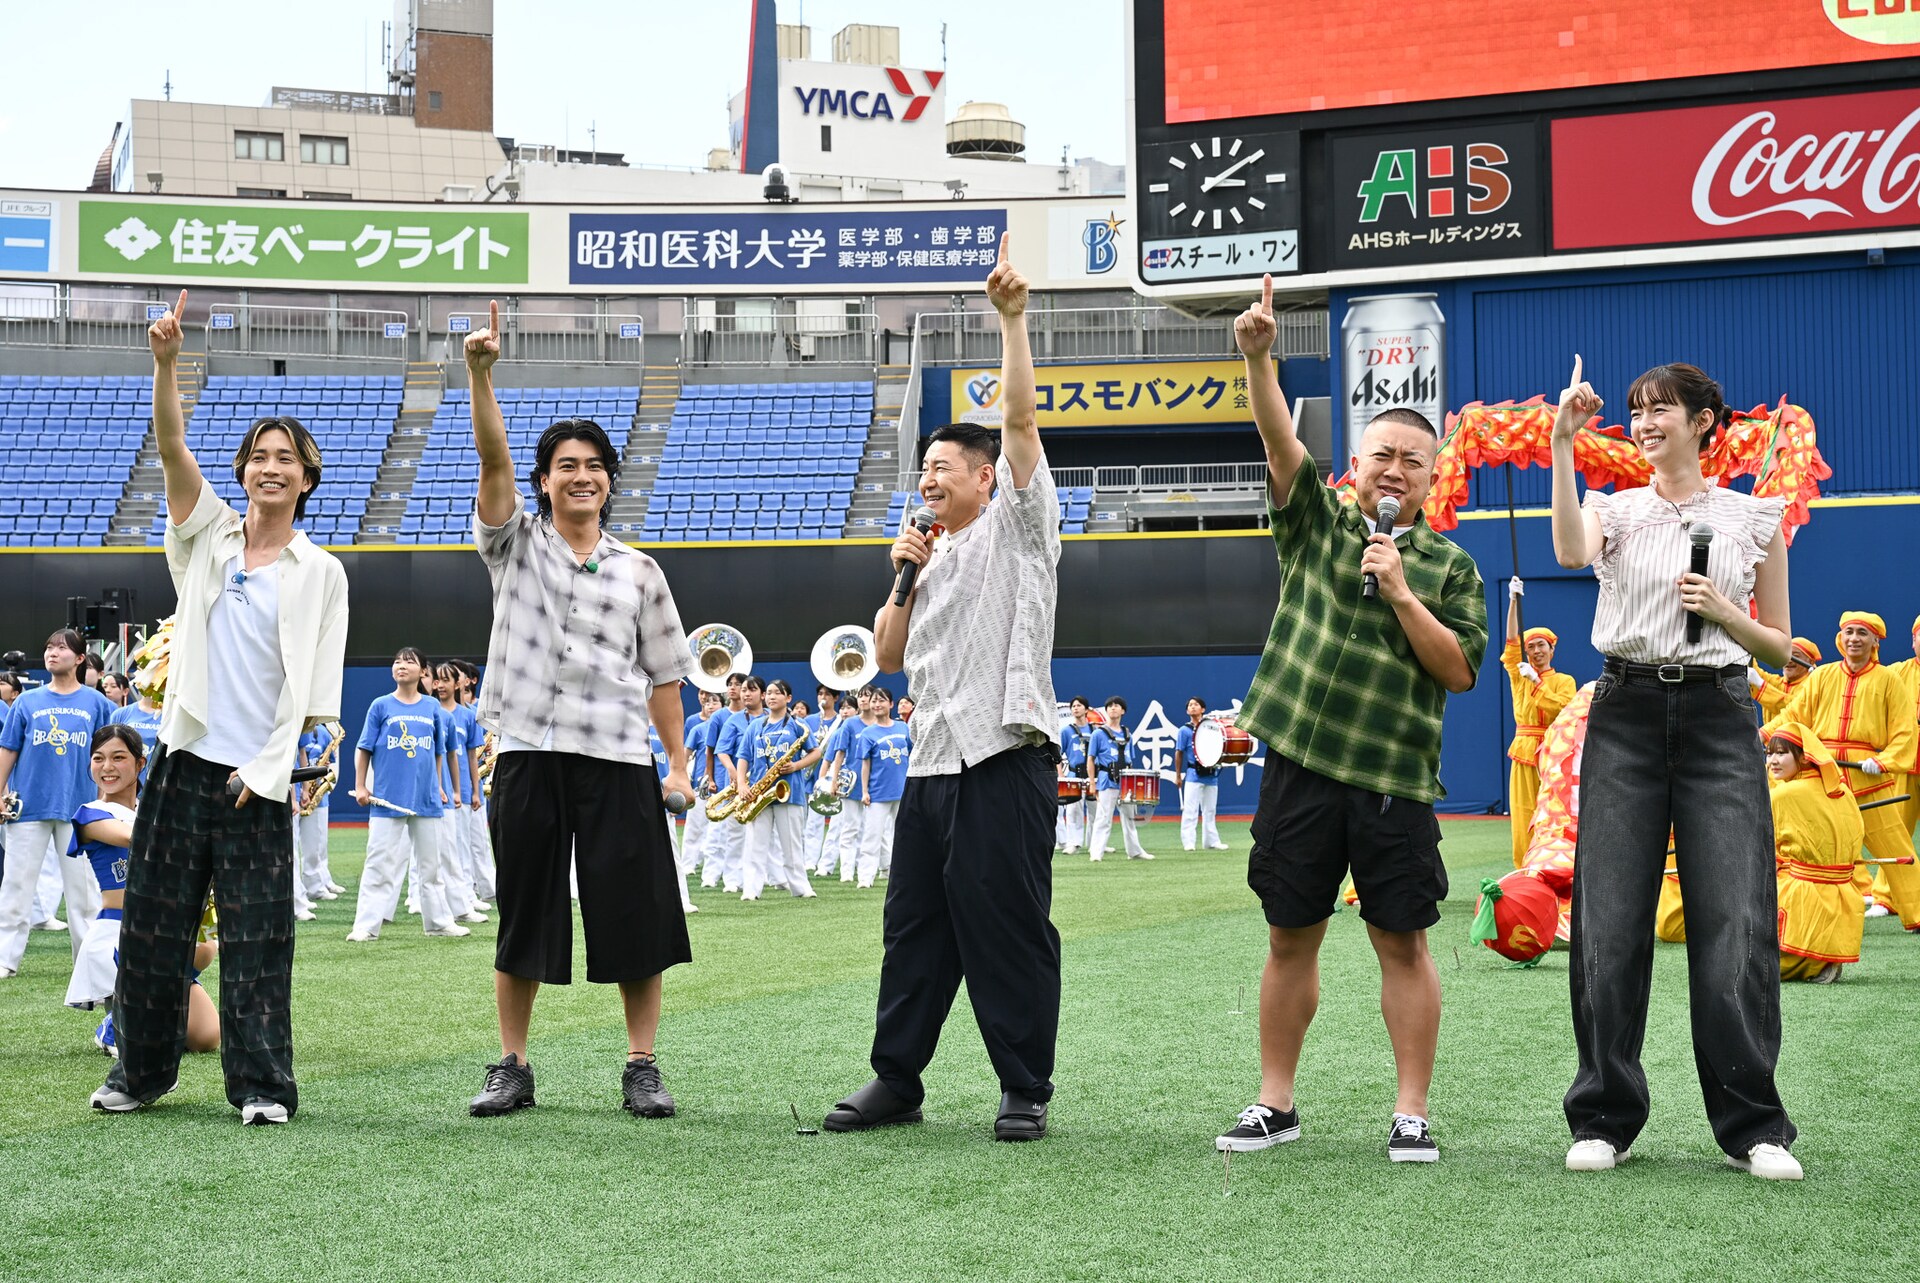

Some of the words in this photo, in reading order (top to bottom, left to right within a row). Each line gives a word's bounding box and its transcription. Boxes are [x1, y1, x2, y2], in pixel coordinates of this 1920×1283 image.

[795, 86, 894, 120] YMCA
[1692, 106, 1920, 226] Coca-C
[1357, 142, 1512, 223] AHS
[169, 217, 510, 270] 住友ベークライト
[577, 228, 827, 270] 昭和医科大学
[838, 249, 996, 268] 薬学部・保健医療学部
[1170, 239, 1297, 269] スチール・ワン
[1377, 336, 1411, 345] SUPER
[1233, 375, 1248, 391] 株
[1352, 364, 1436, 407] Asahi
[1233, 394, 1248, 409] 会
[963, 414, 1003, 422] COSMOBAN
